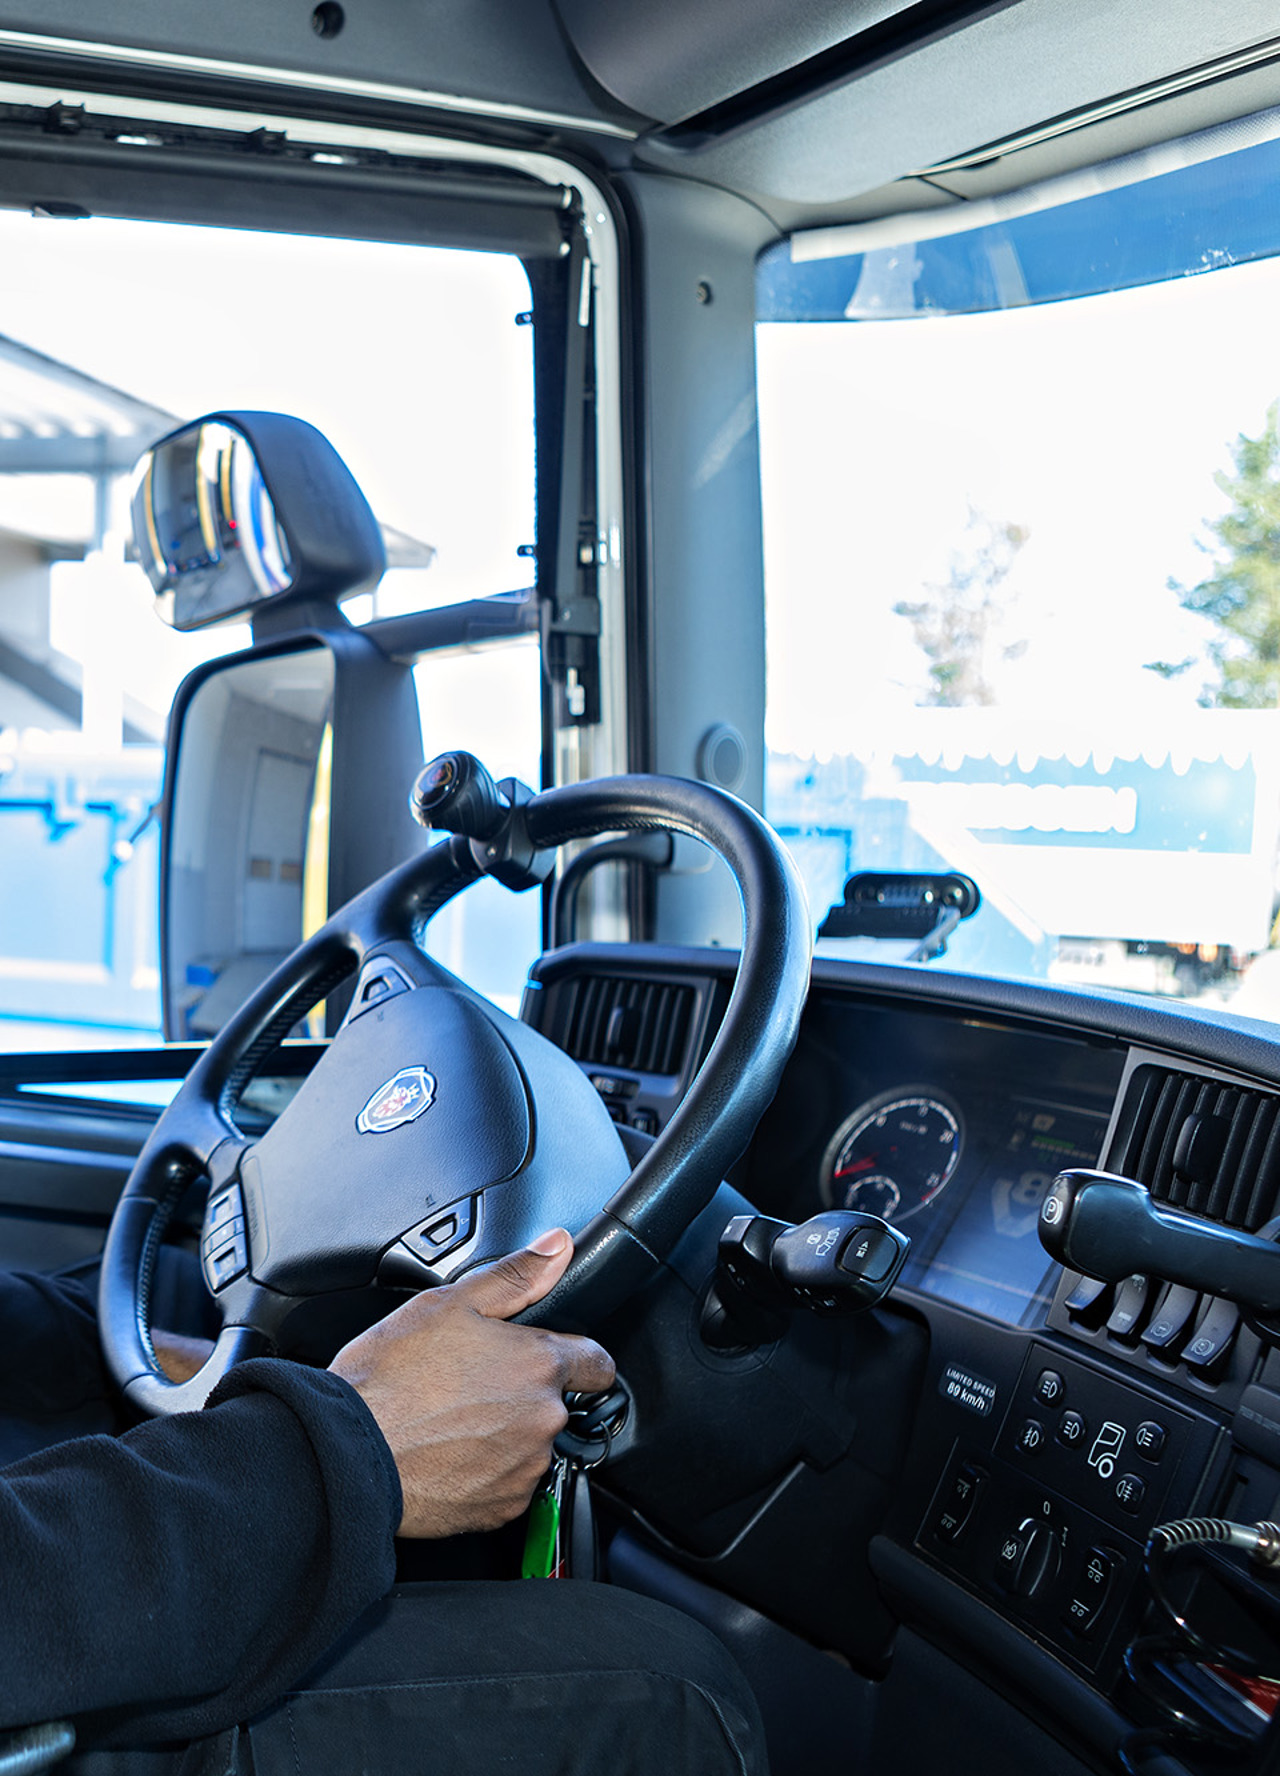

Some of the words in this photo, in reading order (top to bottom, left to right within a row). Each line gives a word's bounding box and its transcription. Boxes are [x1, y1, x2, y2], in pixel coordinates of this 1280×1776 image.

[947, 1381, 961, 1397] 89
[960, 1387, 985, 1410] km/h
[972, 1380, 996, 1398] SPEED
